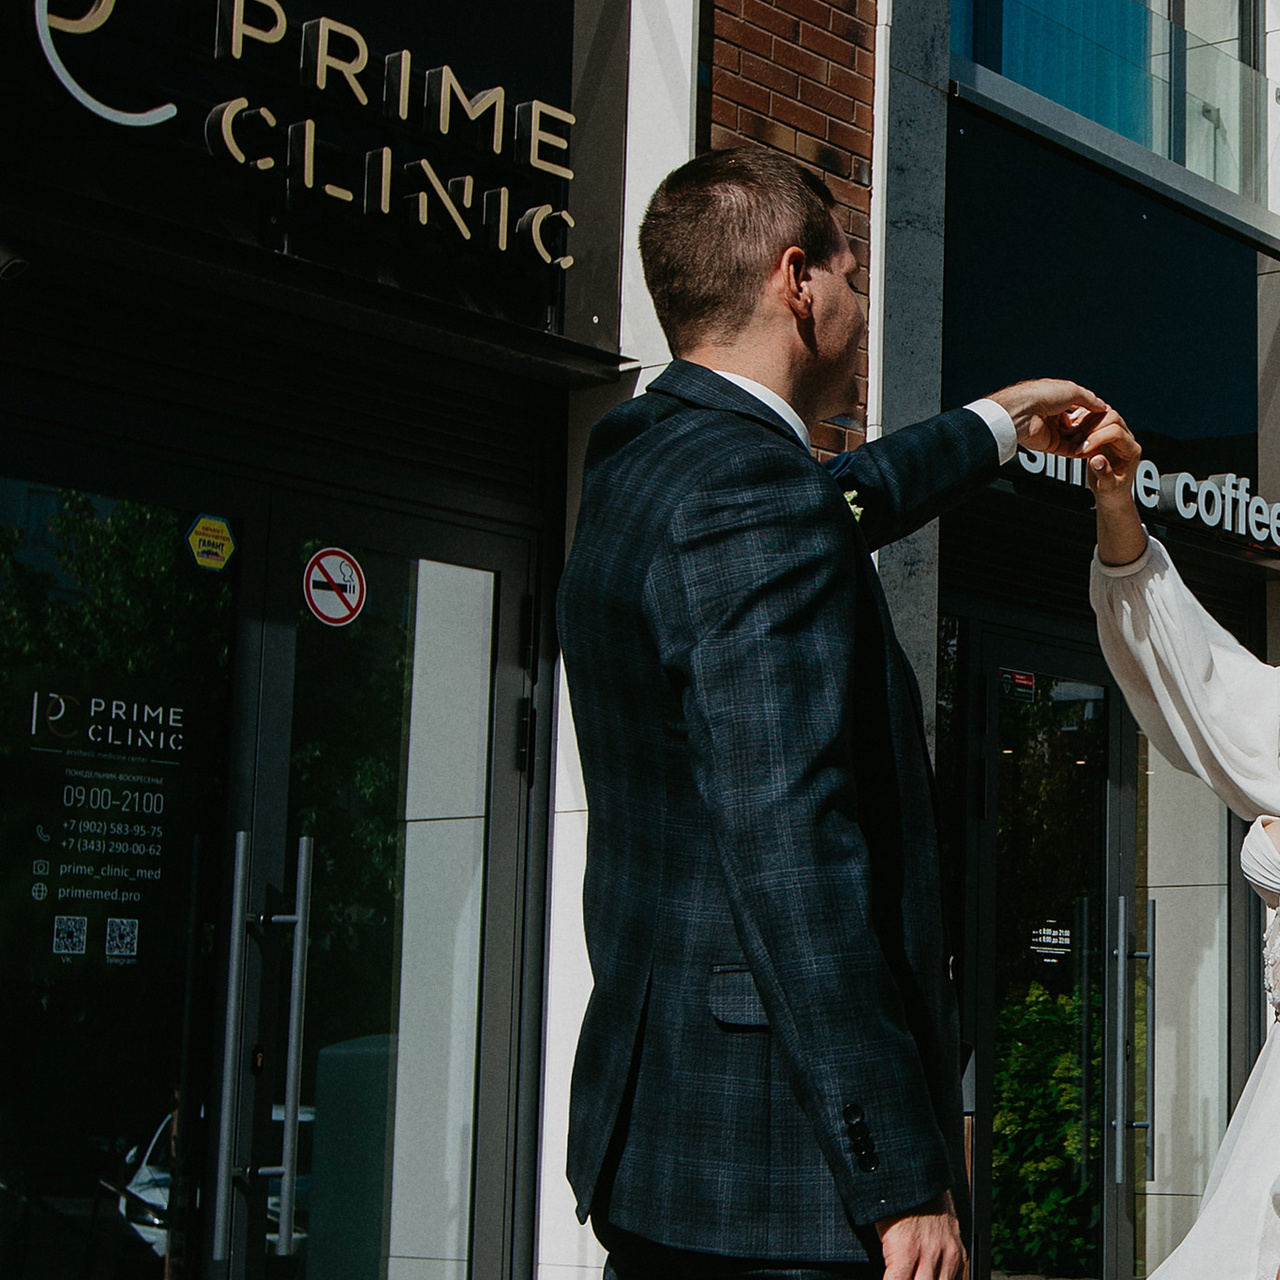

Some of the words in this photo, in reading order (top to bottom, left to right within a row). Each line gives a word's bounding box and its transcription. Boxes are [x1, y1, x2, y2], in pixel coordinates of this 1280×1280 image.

[218, 96, 575, 269] CLINIC
[90, 697, 184, 727] PRIME
[88, 724, 184, 751] CLINIC
[62, 819, 76, 831] +7
[78, 820, 107, 835] (902)
[109, 823, 163, 838] 583-95-75
[61, 838, 75, 849] +7
[77, 838, 106, 855] (343)
[108, 841, 162, 856] 290-00-62
[59, 862, 162, 881] prime_clinic_med
[58, 886, 141, 903] primemed.pro
